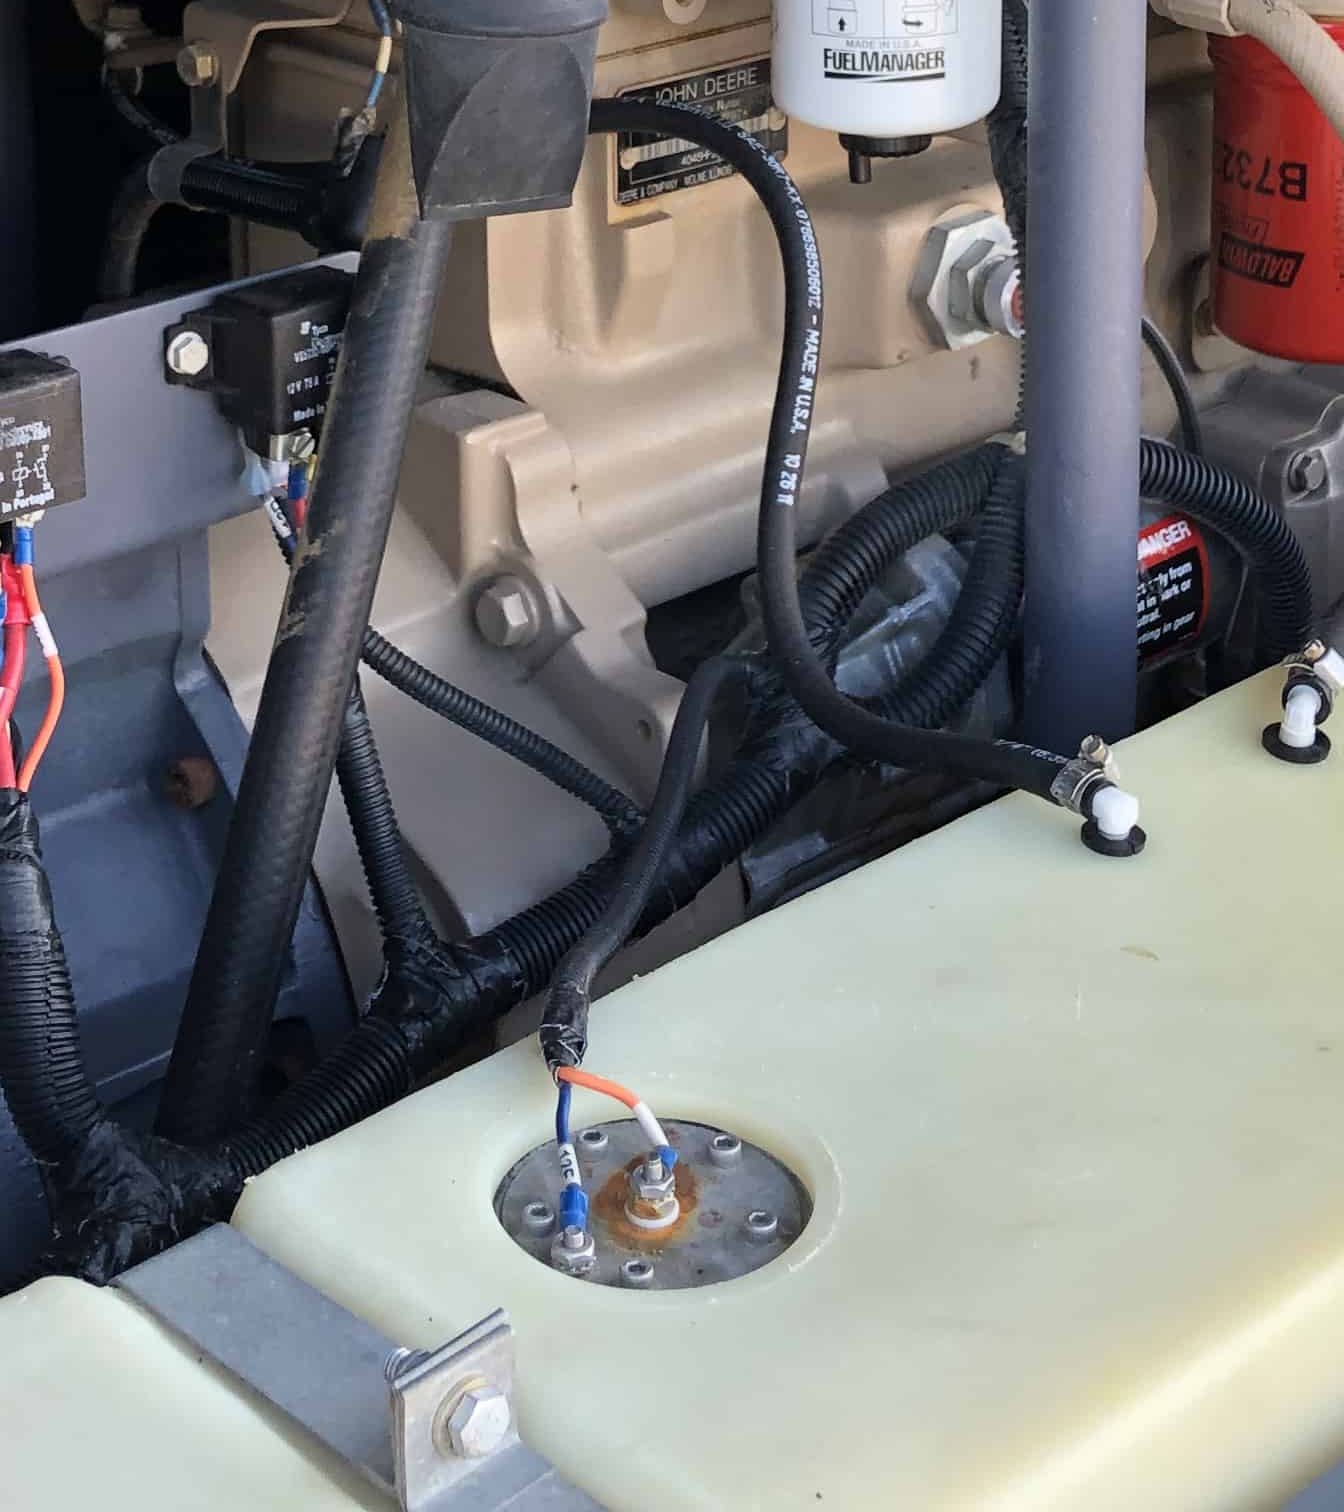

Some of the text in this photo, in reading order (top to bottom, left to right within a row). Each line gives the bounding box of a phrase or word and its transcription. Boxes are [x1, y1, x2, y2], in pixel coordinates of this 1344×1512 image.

[656, 68, 757, 104] JOHN DEERE
[801, 328, 820, 376] MADE
[789, 394, 812, 435] U.S.A.
[13, 487, 55, 510] Portugal
[1136, 519, 1192, 561] ANGER
